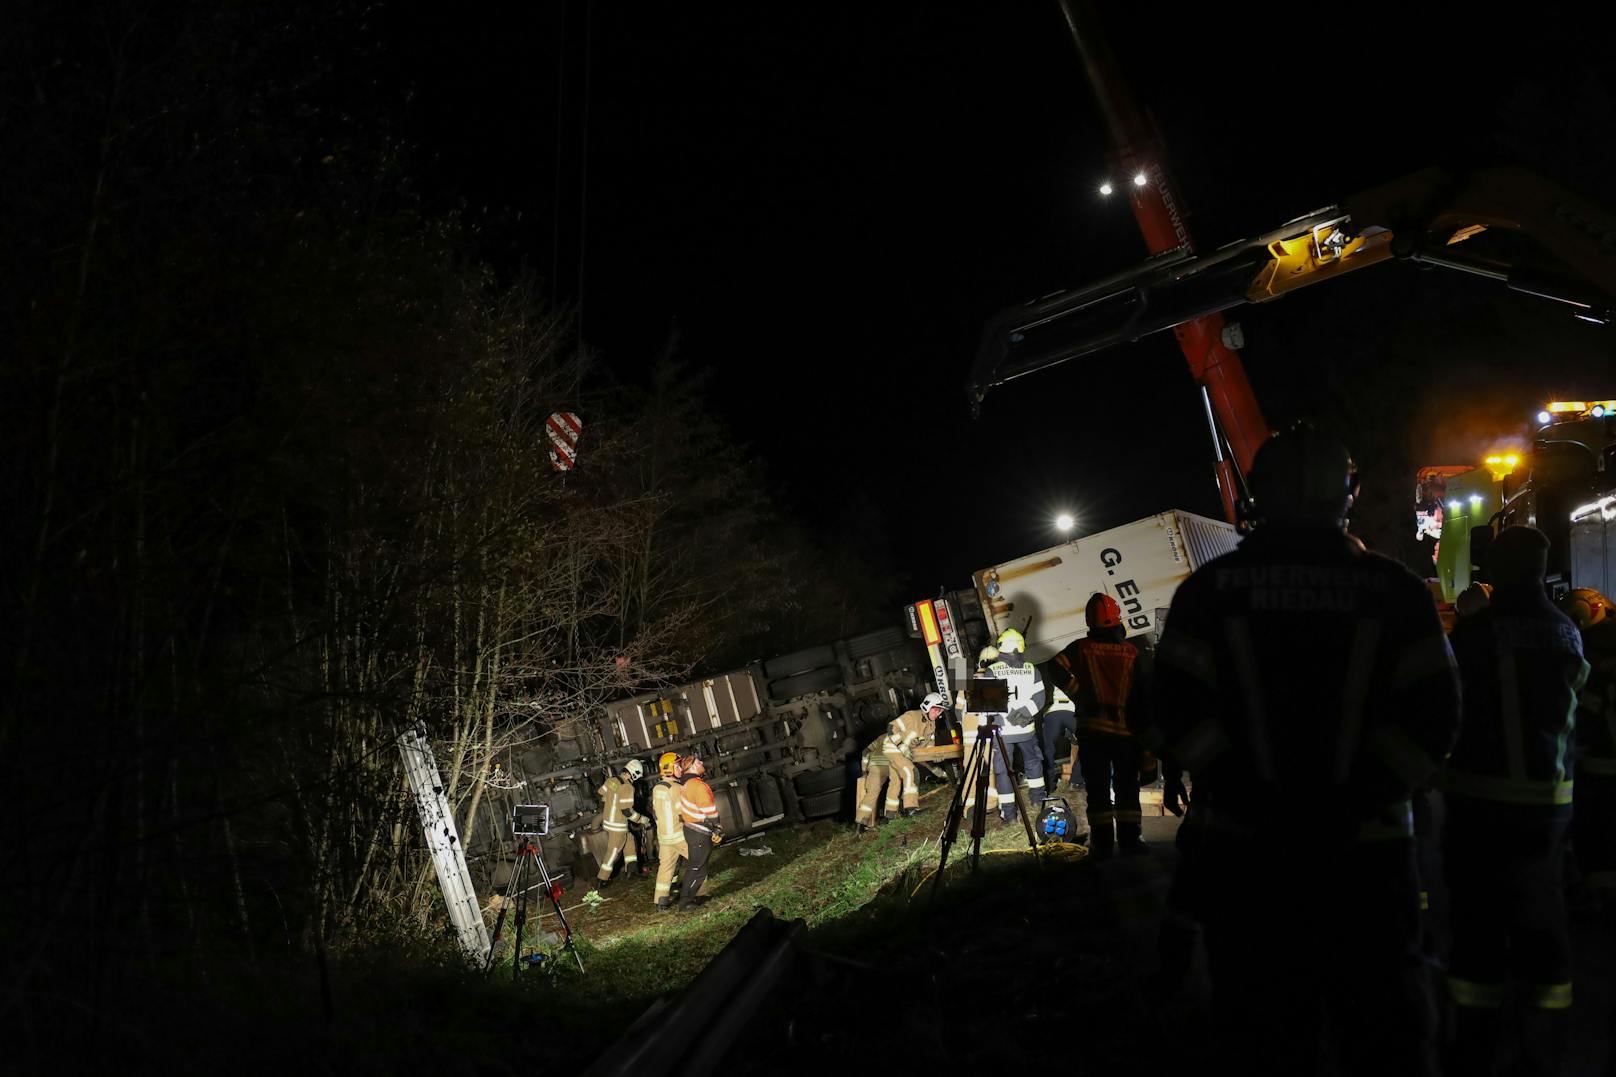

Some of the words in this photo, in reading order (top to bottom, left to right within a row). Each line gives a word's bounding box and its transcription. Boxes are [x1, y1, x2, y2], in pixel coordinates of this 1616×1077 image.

[1100, 548, 1122, 576] G.
[1115, 579, 1151, 630] Eng
[1251, 588, 1356, 612] RIEDAU
[993, 669, 1033, 677] FEUERWEHR
